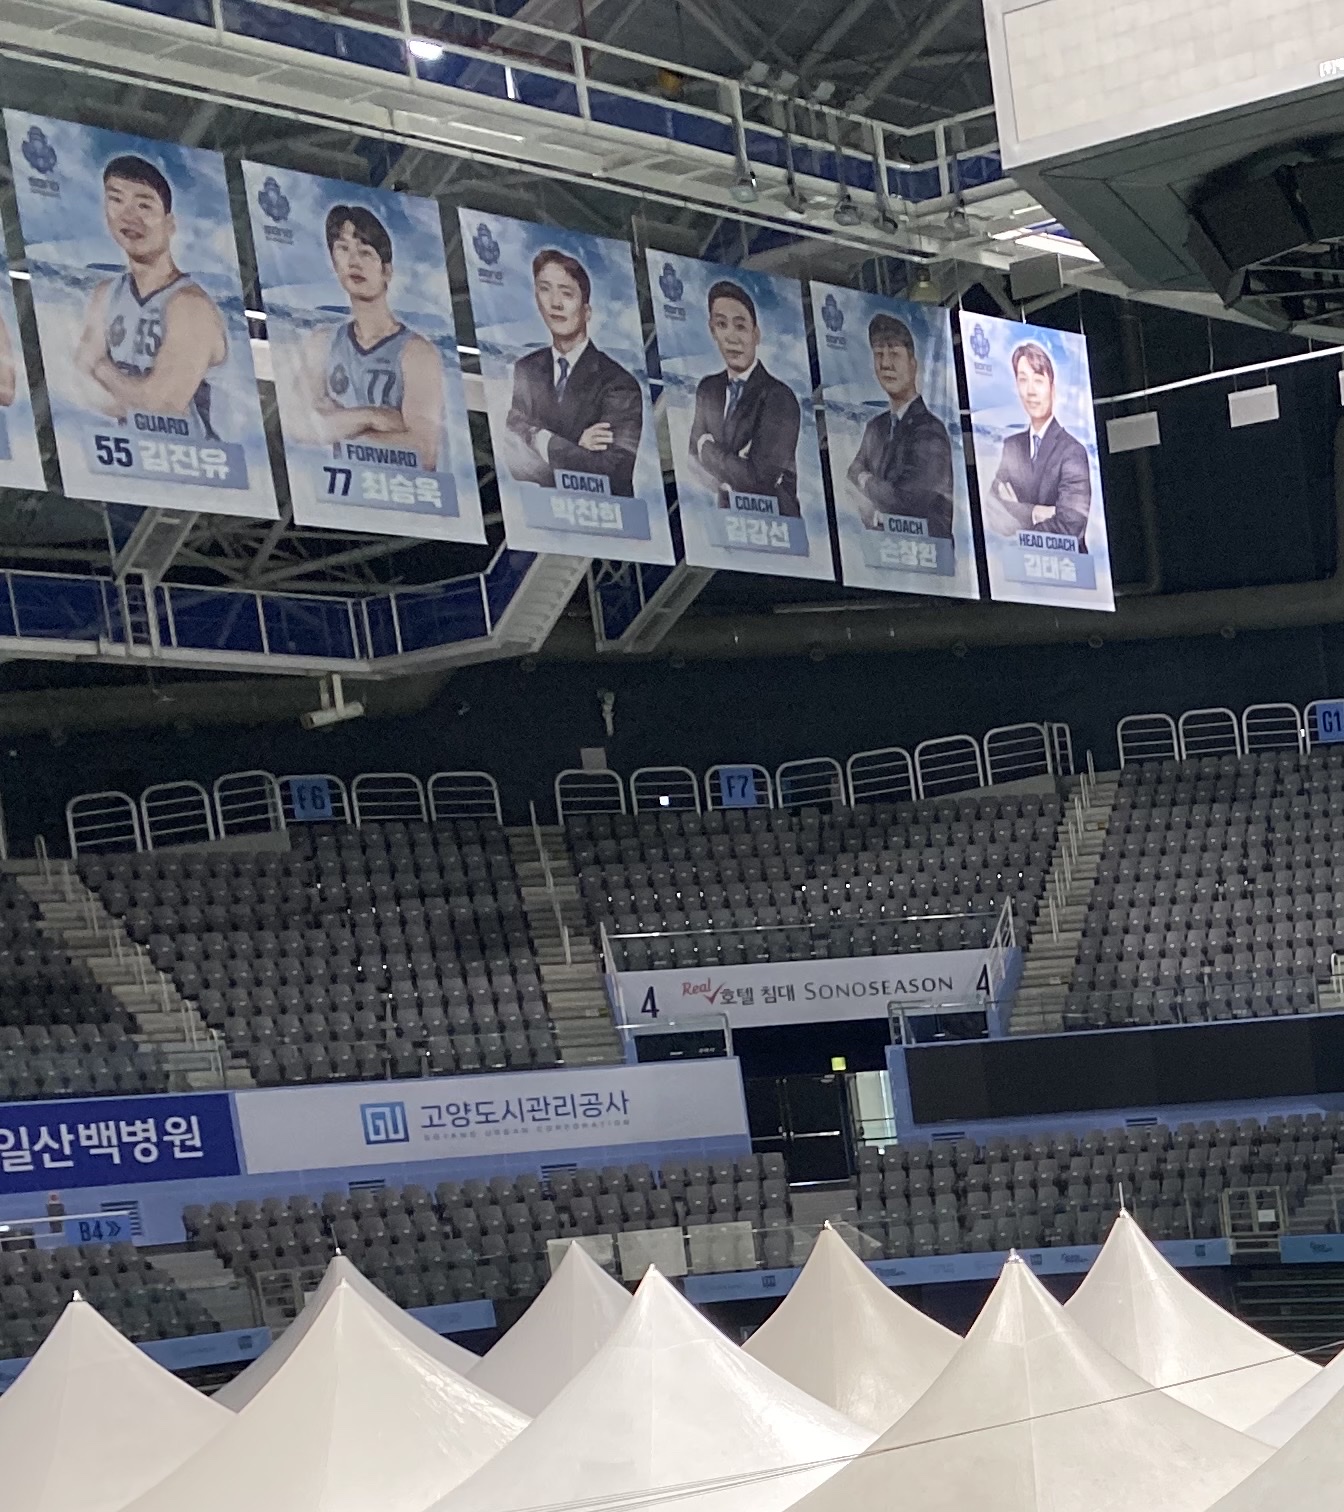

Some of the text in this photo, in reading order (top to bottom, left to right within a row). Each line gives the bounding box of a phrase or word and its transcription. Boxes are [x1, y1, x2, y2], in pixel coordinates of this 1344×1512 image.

[134, 412, 190, 437] GUARD
[94, 434, 134, 467] 55
[139, 439, 231, 480] 김진유
[346, 443, 419, 469] FORWARD
[323, 465, 353, 497] 77
[361, 470, 443, 509] 최승욱
[561, 473, 605, 494] COACH
[735, 495, 775, 514] COACH
[888, 515, 924, 535] COACH
[1019, 532, 1076, 553] HEAD COACH
[1322, 709, 1343, 733] G1
[727, 774, 749, 799] F7
[682, 977, 713, 998] Real
[720, 976, 955, 1006] 호텔 침대 SONOSEASON
[976, 963, 990, 996] 4
[641, 985, 659, 1019] 4
[420, 1089, 631, 1130] 고양도시관리공사
[0, 1114, 204, 1173] 일산백병원
